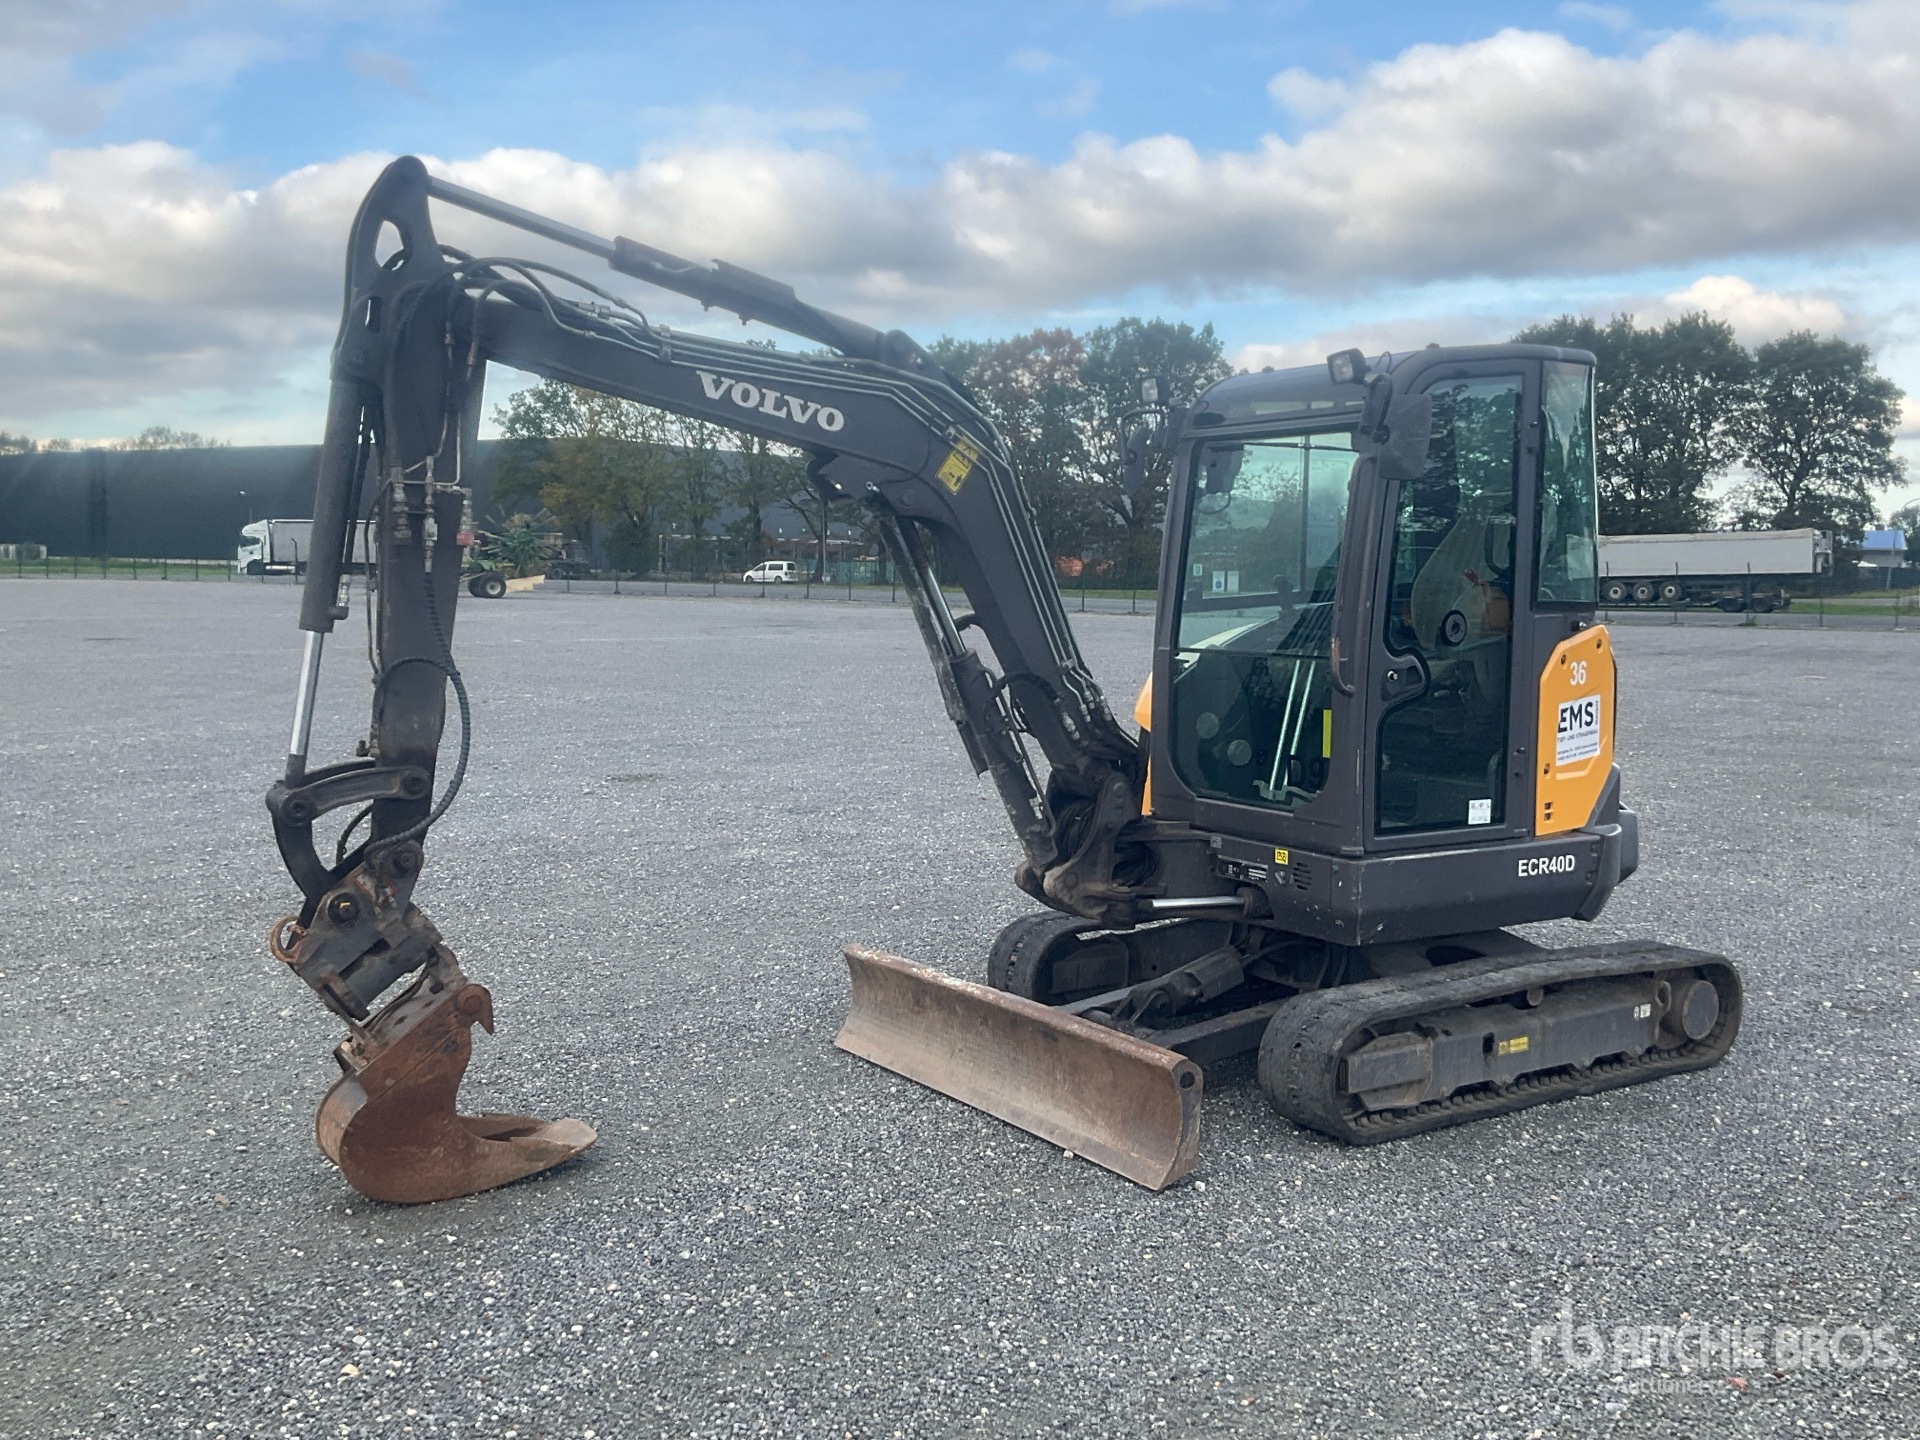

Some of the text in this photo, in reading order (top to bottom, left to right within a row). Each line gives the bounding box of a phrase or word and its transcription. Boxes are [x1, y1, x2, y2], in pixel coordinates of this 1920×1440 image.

[696, 370, 845, 432] VOLVO
[1569, 660, 1587, 686] 36
[1557, 701, 1594, 733] EMS
[1518, 854, 1576, 877] ECR40D
